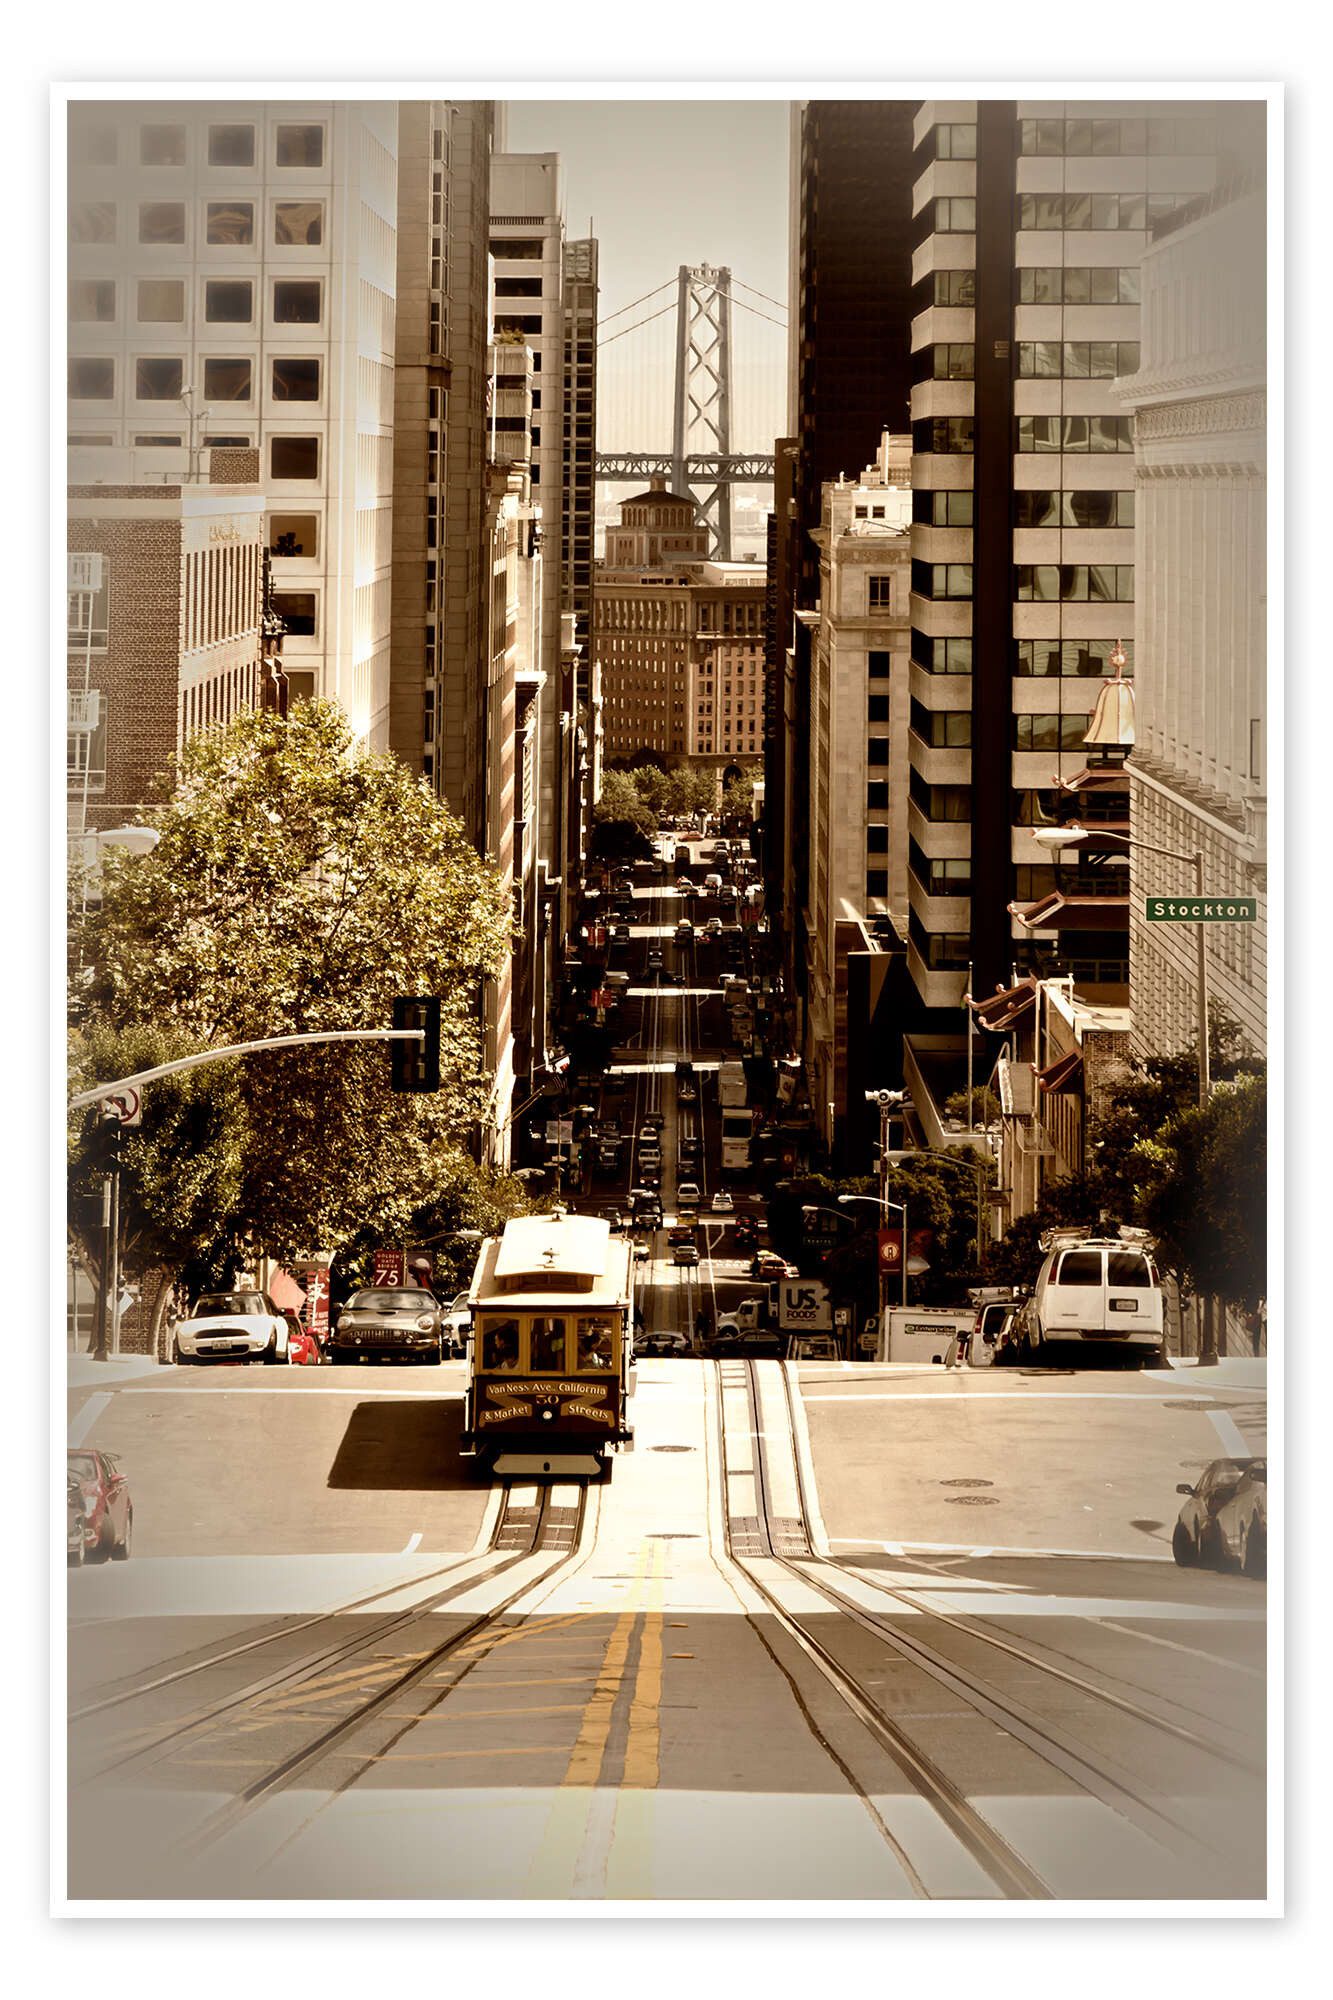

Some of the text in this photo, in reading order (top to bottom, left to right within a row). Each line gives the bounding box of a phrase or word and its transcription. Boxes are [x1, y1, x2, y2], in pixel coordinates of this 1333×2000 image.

[1154, 903, 1249, 916] Stockton
[375, 1269, 399, 1286] 75
[786, 1311, 816, 1319] FOODS
[488, 1385, 506, 1395] Van
[506, 1383, 529, 1393] Ness
[558, 1383, 606, 1395] California
[535, 1394, 559, 1404] 50
[484, 1405, 608, 1420] & Market Streets
